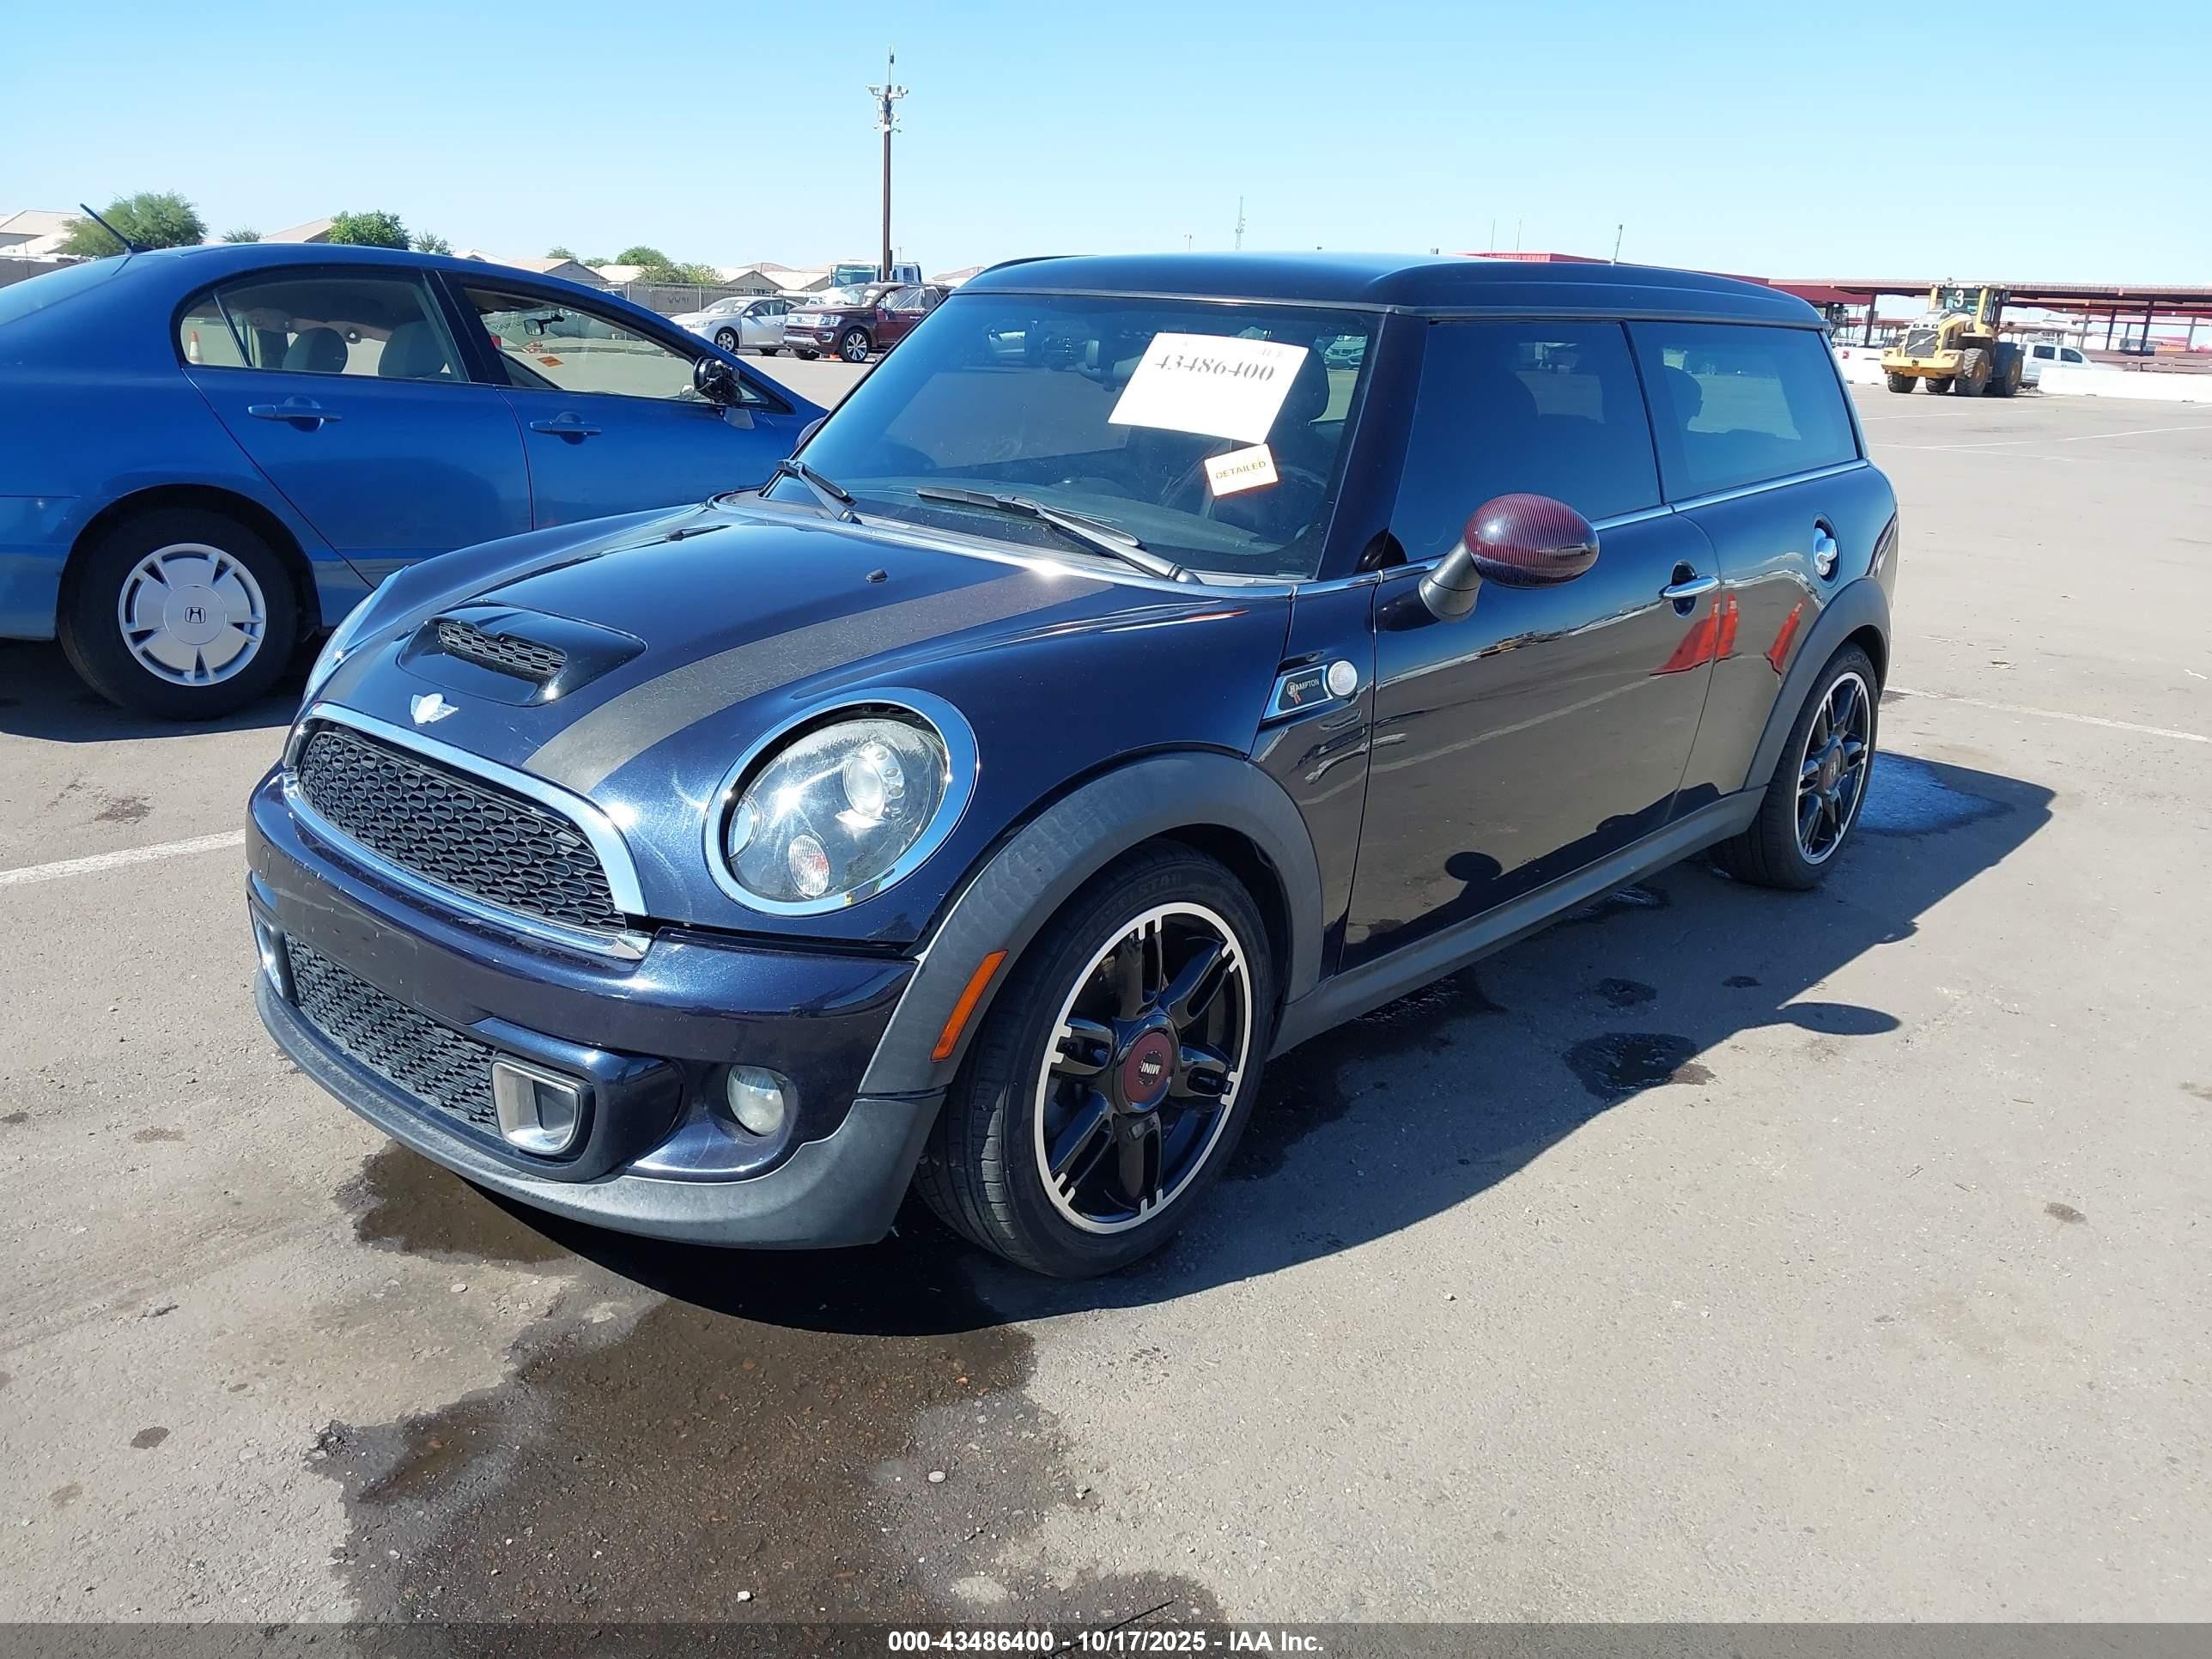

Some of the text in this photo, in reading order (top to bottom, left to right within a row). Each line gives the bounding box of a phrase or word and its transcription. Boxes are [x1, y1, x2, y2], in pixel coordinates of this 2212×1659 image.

[1954, 289, 1965, 308] 3
[1155, 355, 1275, 381] 43486400
[1216, 460, 1267, 480] DETAILED
[1290, 678, 1320, 694] HAMPTON
[1141, 1062, 1161, 1075] MINI
